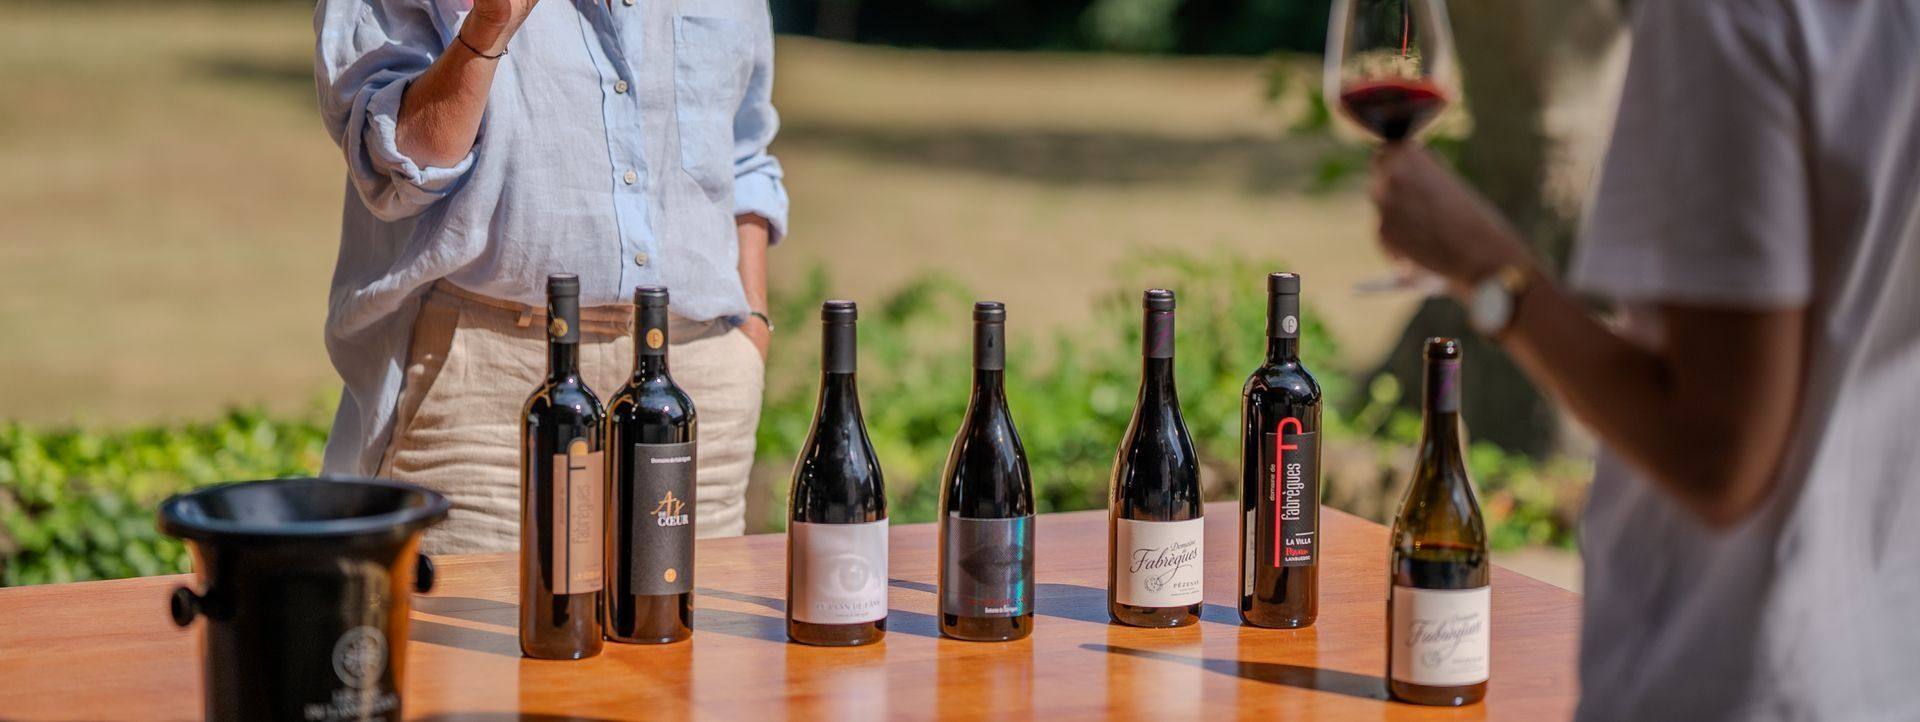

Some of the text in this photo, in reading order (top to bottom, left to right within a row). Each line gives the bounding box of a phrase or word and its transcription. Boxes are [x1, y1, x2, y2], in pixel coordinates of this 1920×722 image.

[1269, 463, 1276, 473] de
[1280, 463, 1305, 521] fabrègues
[1285, 538, 1295, 546] LA
[1129, 547, 1198, 585] Fabrègues
